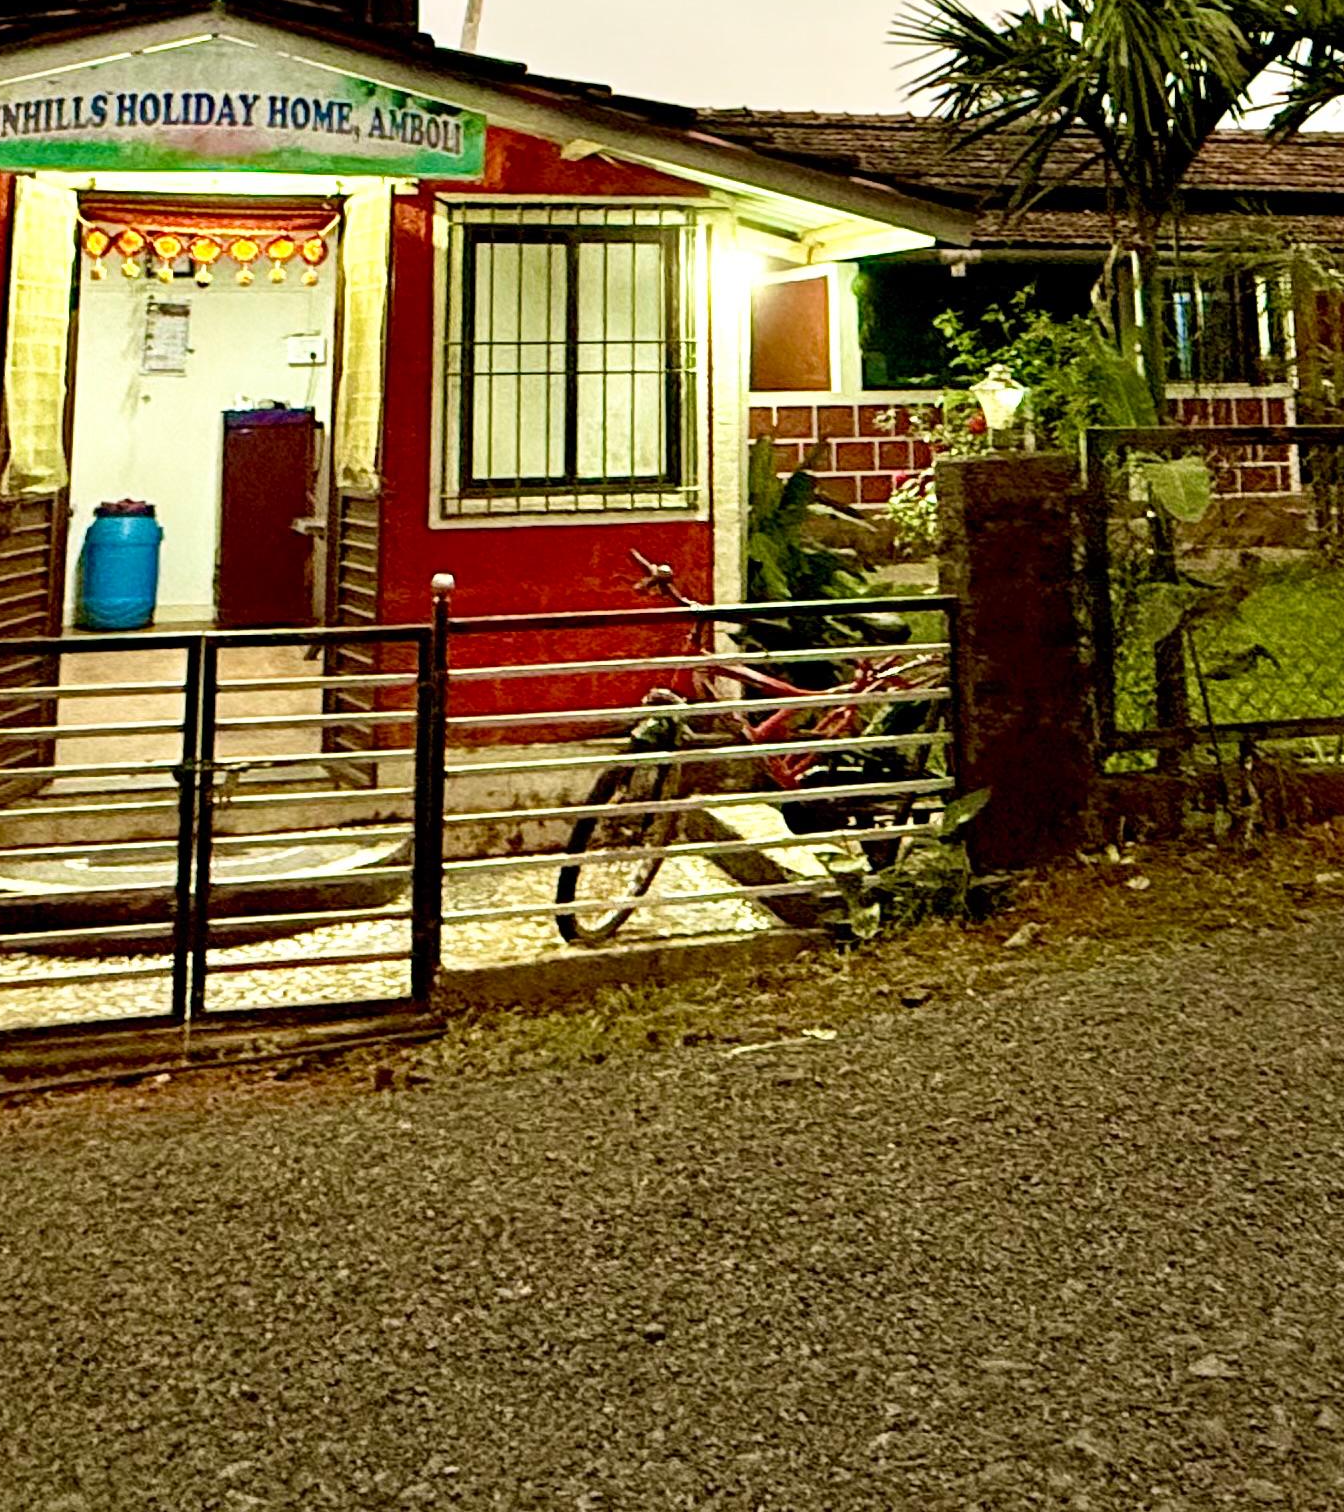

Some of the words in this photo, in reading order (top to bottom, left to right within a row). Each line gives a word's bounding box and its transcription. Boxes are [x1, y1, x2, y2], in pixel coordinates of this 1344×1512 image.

[116, 92, 260, 126] HOLIDAY
[267, 95, 360, 142] HOME,
[368, 106, 462, 154] AMBOLI
